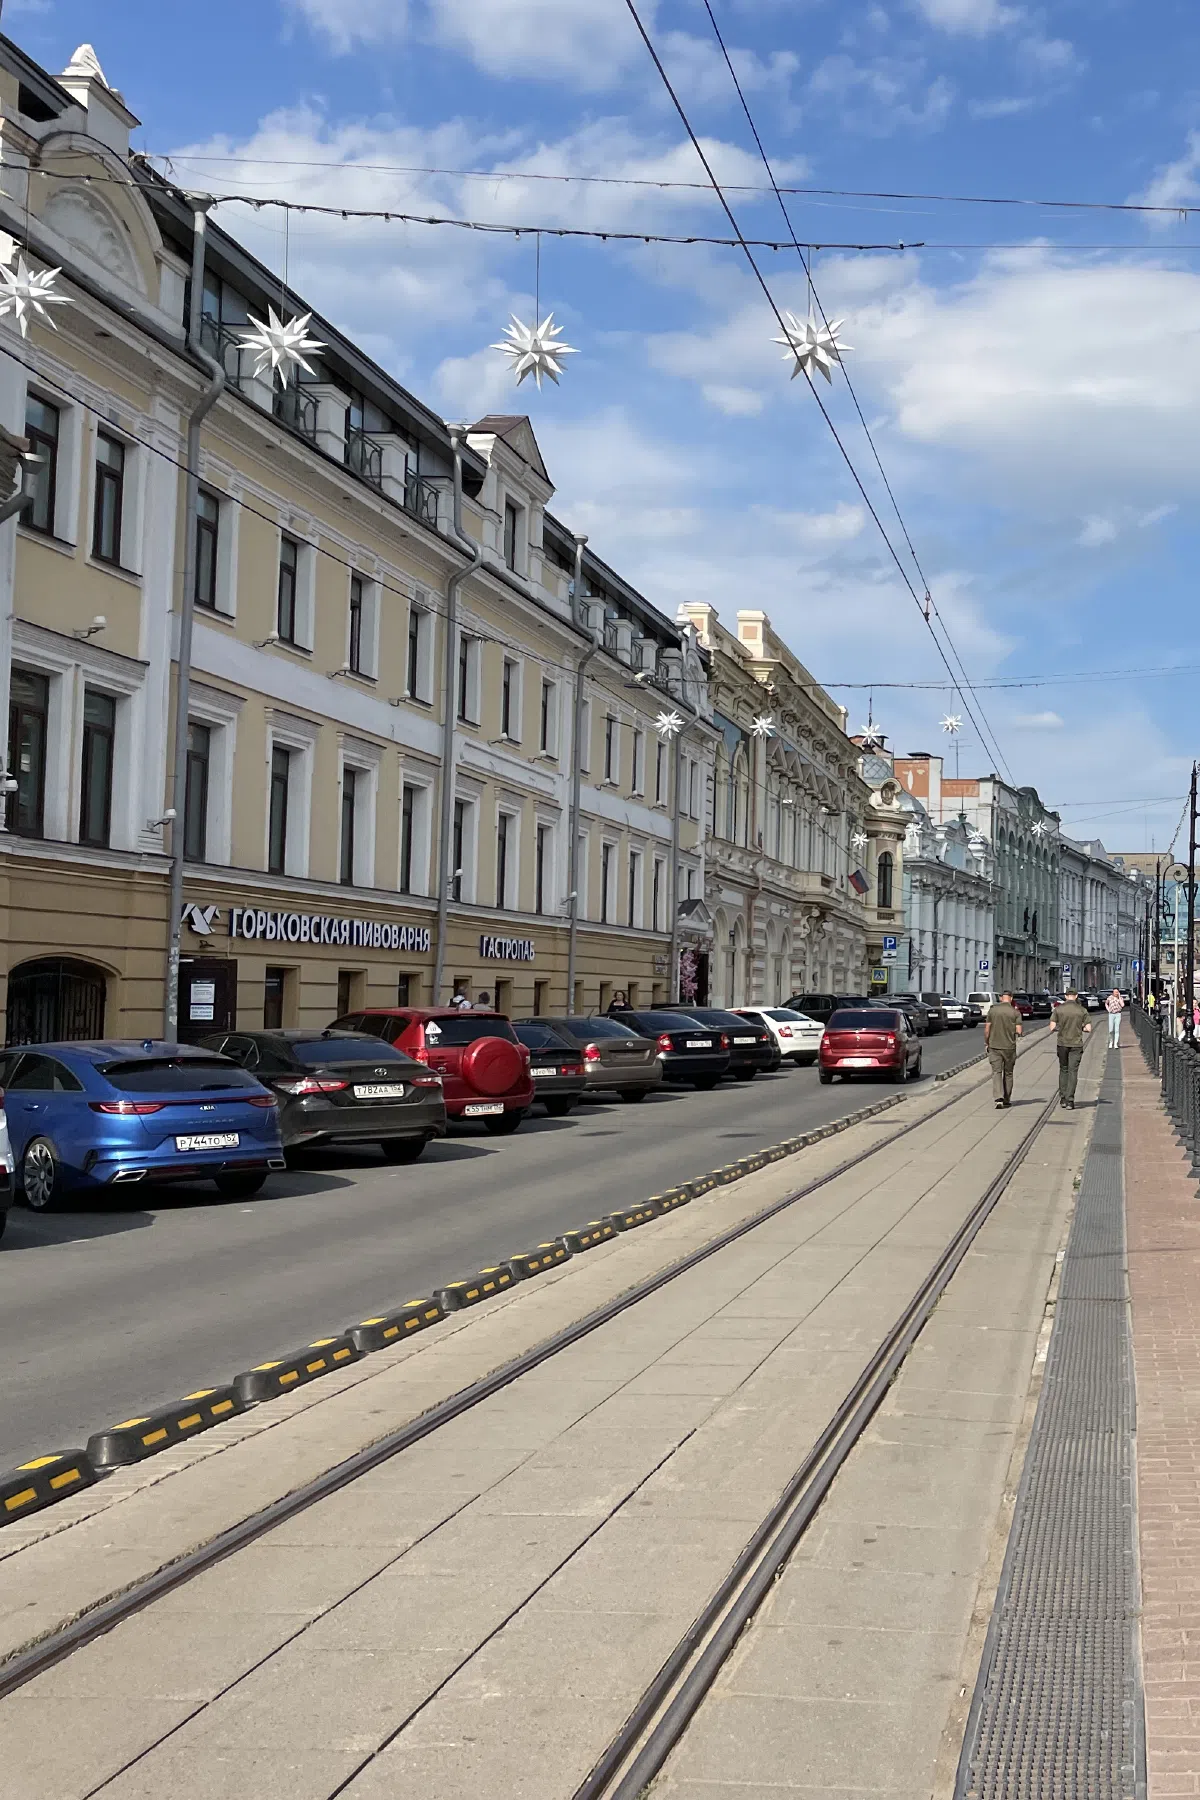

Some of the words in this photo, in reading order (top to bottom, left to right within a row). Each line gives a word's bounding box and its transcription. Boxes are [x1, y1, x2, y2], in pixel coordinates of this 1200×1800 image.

[231, 908, 350, 945] ГОРЬКОВСКАЯ
[353, 919, 431, 952] ПИВОВАРНЯ
[482, 936, 536, 961] ГАСТРОПАБ
[886, 938, 895, 948] P
